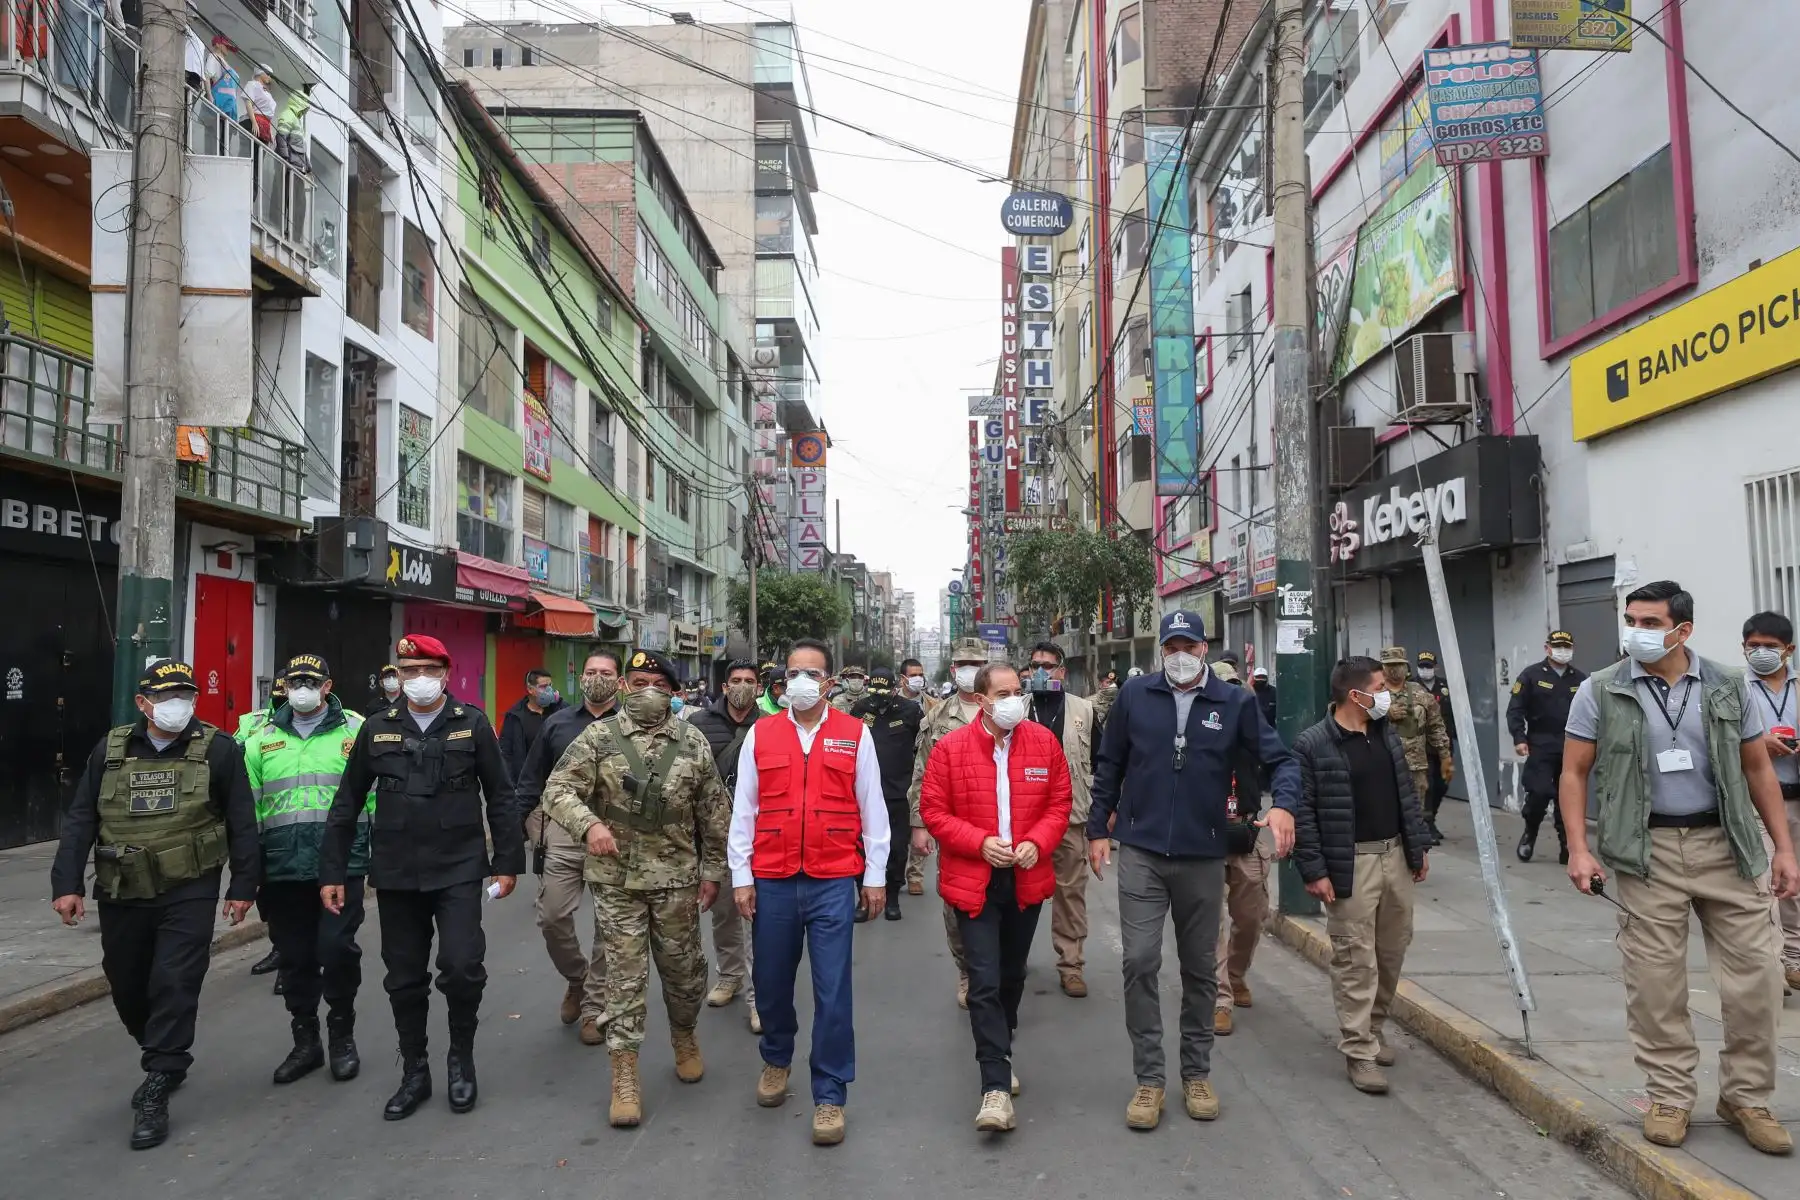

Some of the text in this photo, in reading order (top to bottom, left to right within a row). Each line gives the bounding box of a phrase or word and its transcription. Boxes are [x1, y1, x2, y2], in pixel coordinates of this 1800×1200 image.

[1515, 11, 1558, 20] CASACAS
[1580, 20, 1617, 36] 324
[1516, 34, 1571, 44] MANDILES
[1428, 46, 1530, 67] BUZOS
[1429, 60, 1535, 85] POLOS
[1431, 82, 1483, 103] CASACAS
[1436, 97, 1536, 121] CHALECOS
[1438, 135, 1544, 162] TDA 328
[1012, 199, 1058, 211] GALERIA
[1007, 214, 1066, 228] COMERCIAL
[1638, 322, 1730, 385] BANCO
[1003, 283, 1019, 470] INDUSTRIAL
[1363, 476, 1467, 547] Kebeya
[402, 548, 432, 586] Lois
[155, 663, 193, 679] POLICIA
[291, 656, 322, 670] POLICIA
[139, 772, 165, 780] VELASCO
[132, 789, 173, 799] POLICIA
